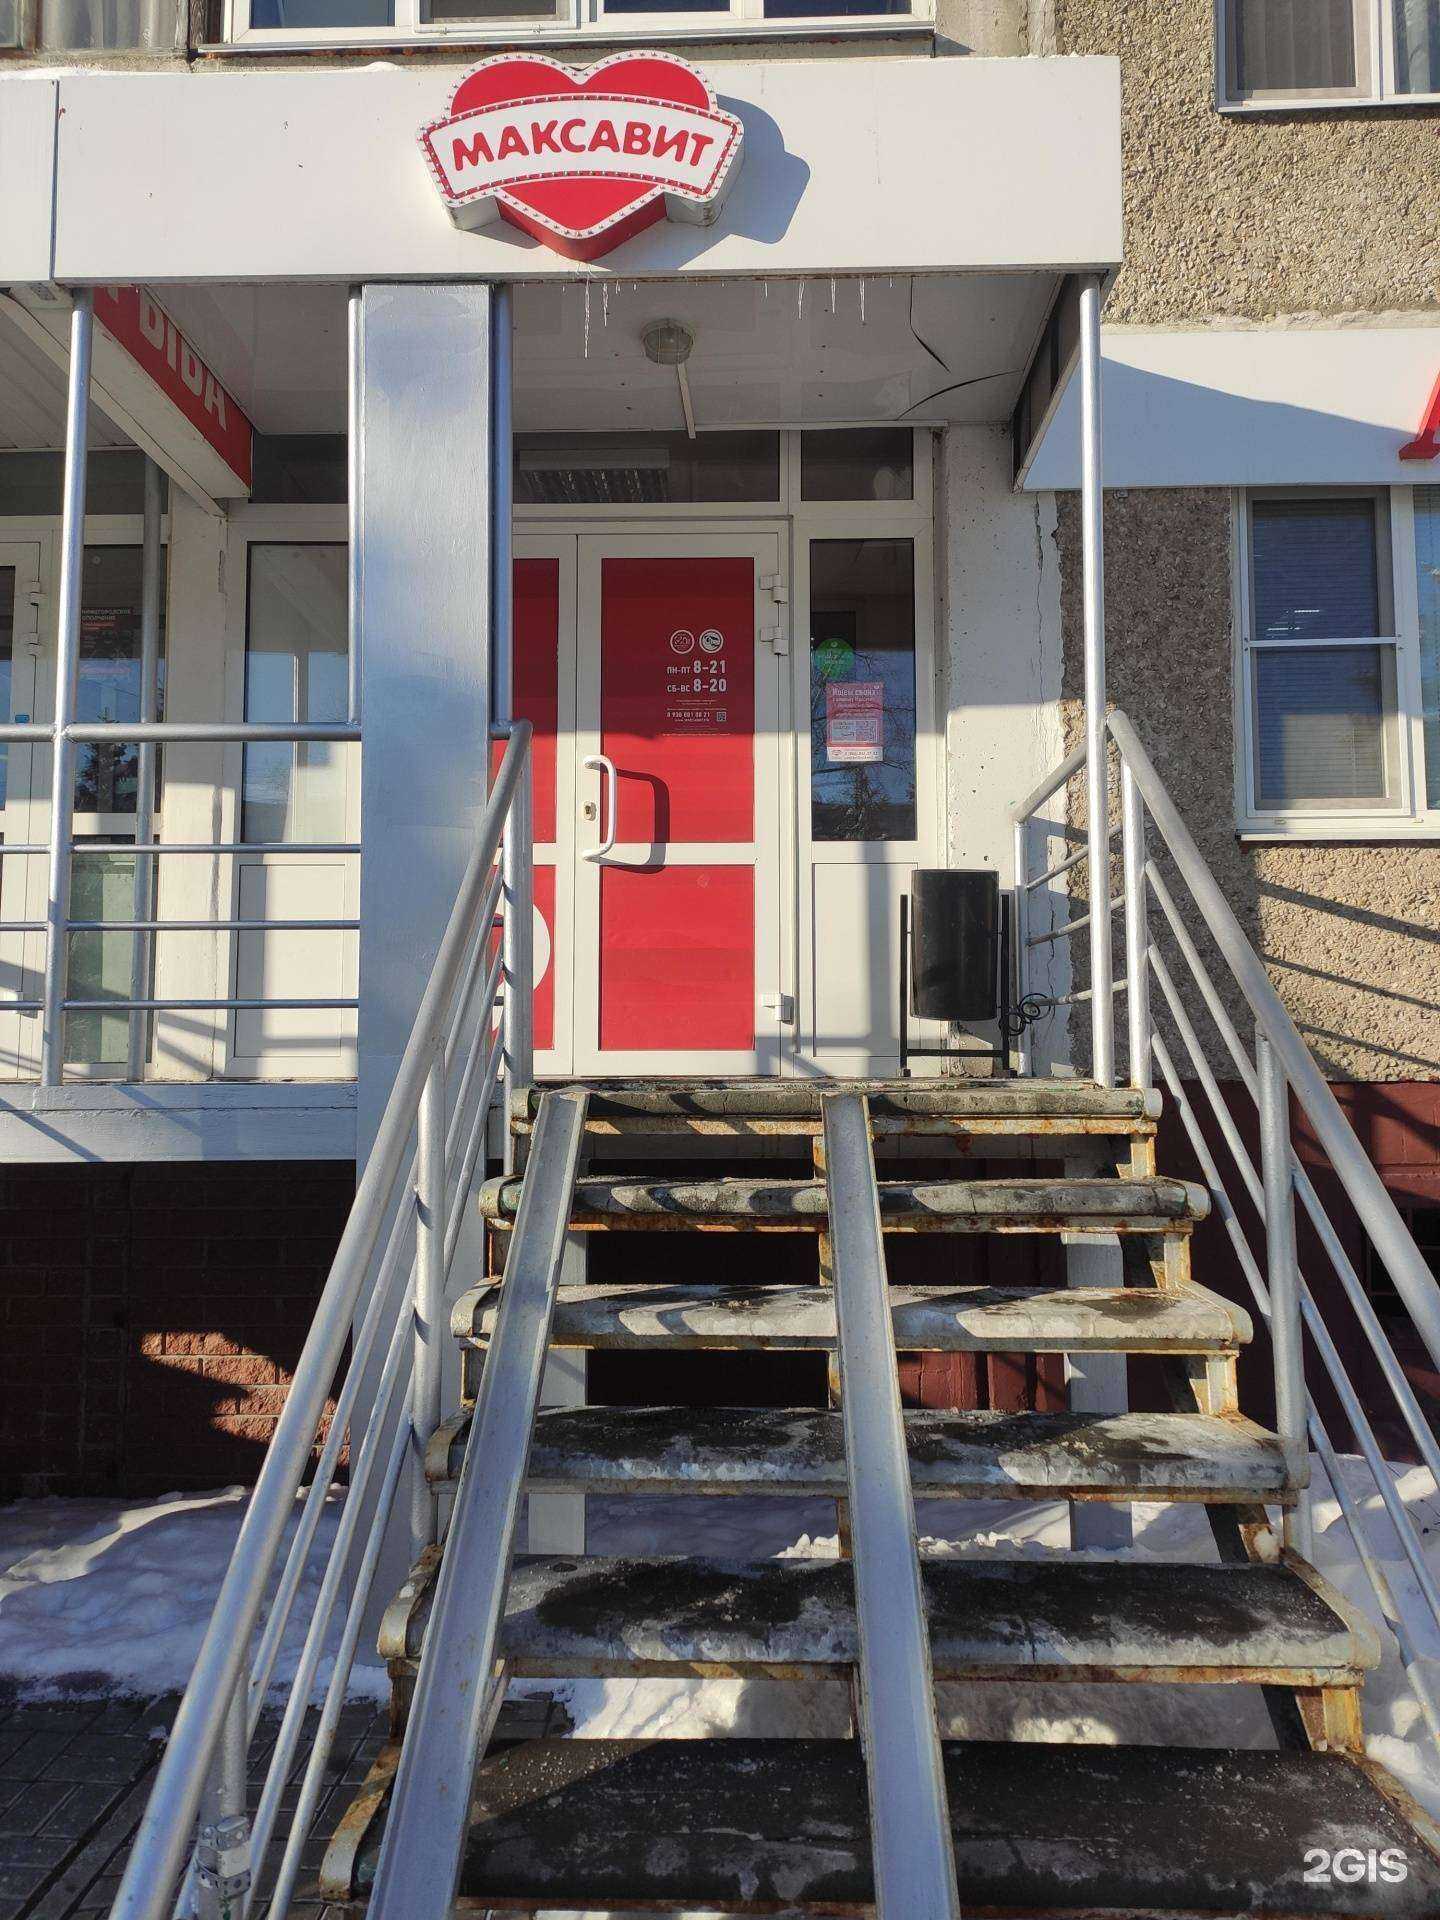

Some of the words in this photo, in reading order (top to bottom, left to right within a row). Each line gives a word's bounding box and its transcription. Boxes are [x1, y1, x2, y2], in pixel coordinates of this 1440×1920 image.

[451, 118, 714, 171] МАКСАВИТ
[693, 660, 726, 674] 8-21
[667, 684, 691, 692] СБ-ВС
[693, 679, 727, 692] 8-20
